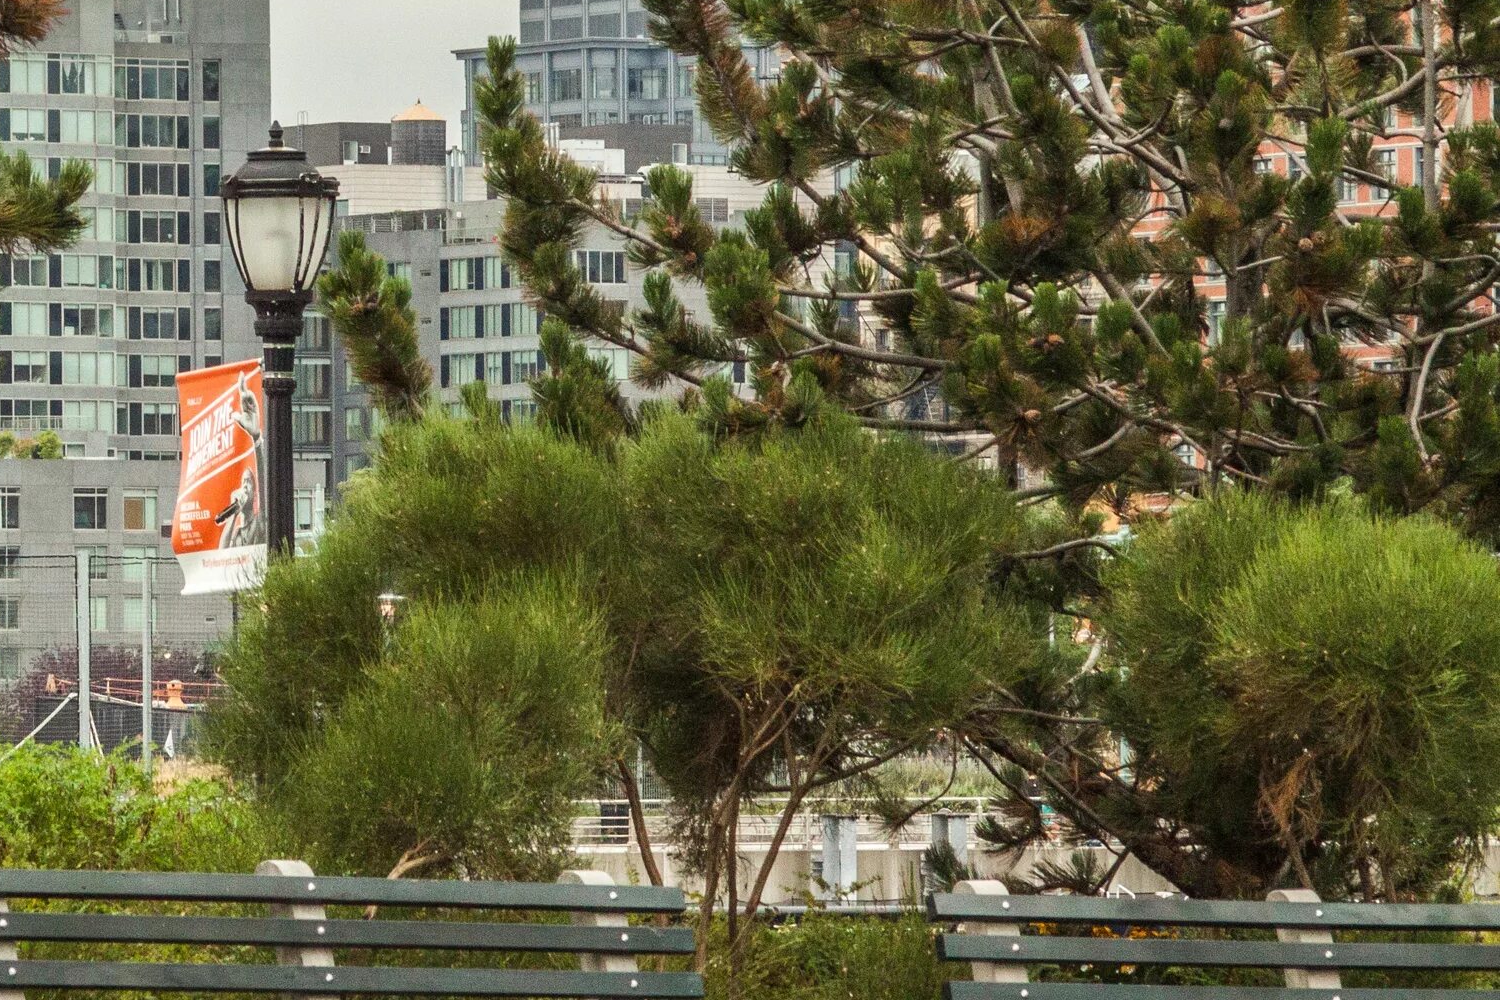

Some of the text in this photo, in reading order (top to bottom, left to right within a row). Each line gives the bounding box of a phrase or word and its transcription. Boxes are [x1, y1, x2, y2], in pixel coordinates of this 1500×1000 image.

[186, 424, 235, 477] MOVEMENT
[189, 397, 234, 457] JOIN THE
